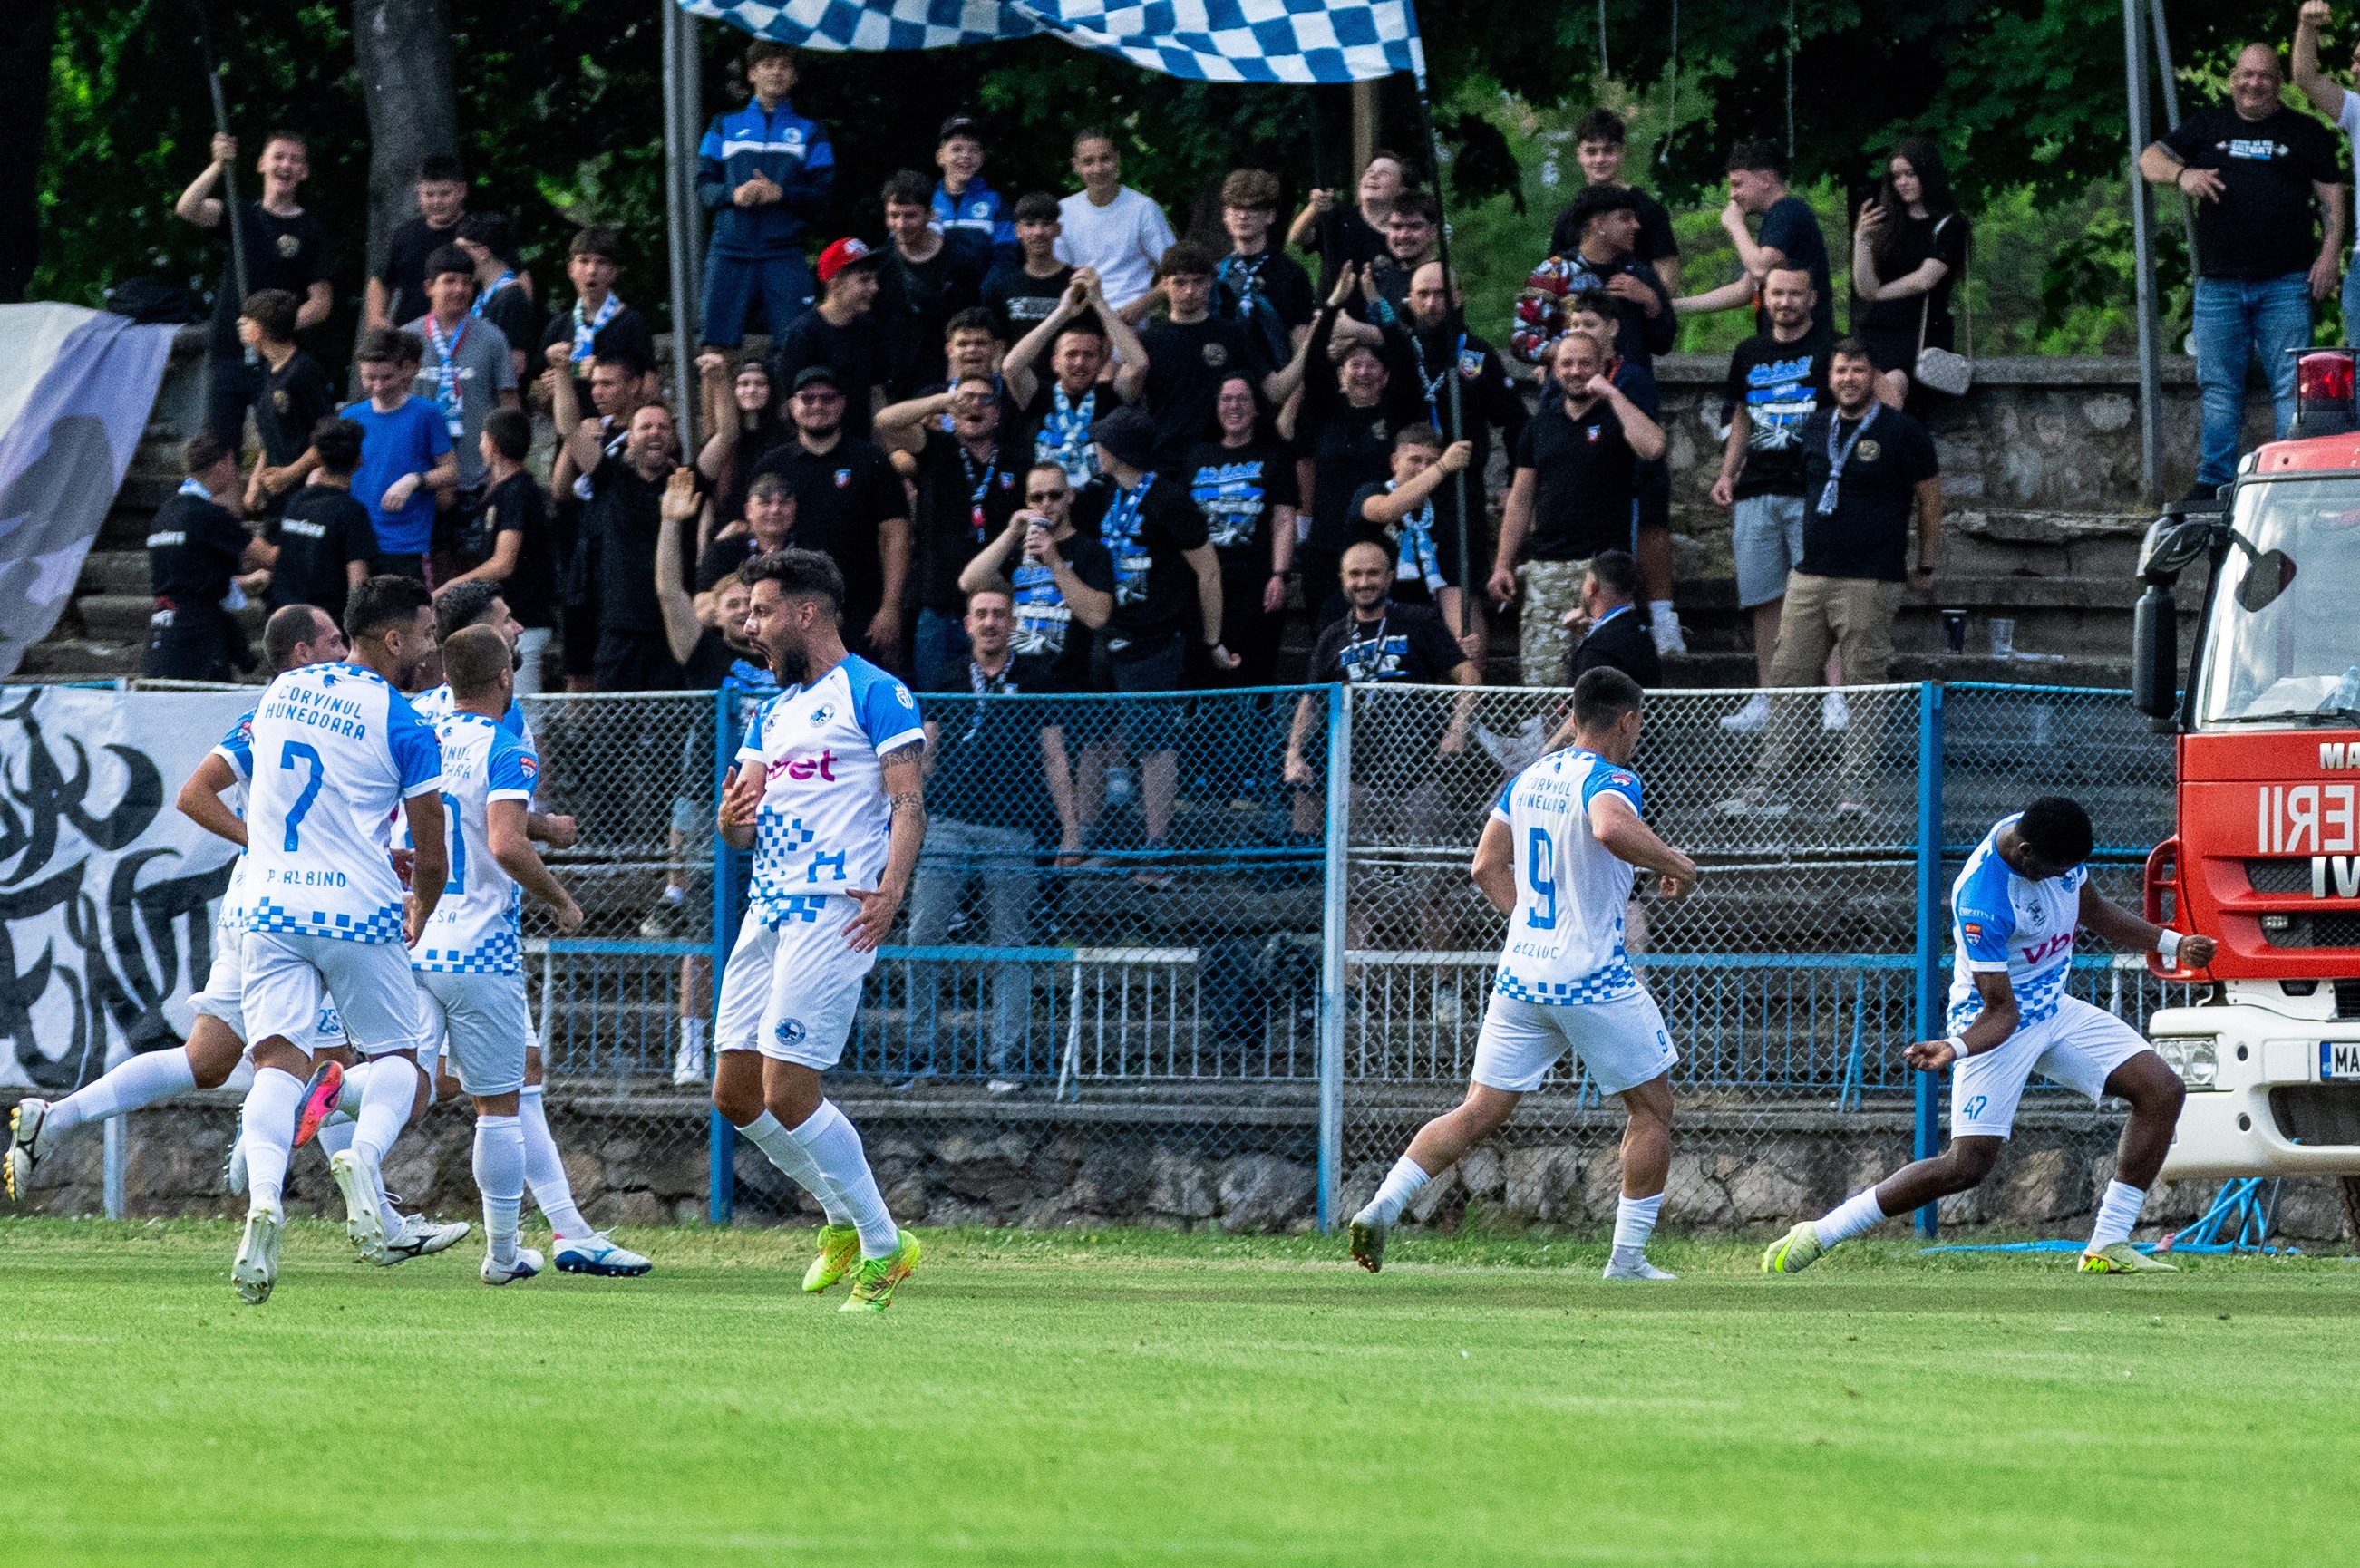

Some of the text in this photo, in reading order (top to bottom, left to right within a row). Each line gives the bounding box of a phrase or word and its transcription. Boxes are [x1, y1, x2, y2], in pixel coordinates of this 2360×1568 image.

[278, 685, 362, 720] CORVINUL
[265, 702, 366, 740] HUNEDOARA
[280, 740, 324, 852] 7
[1527, 826, 1557, 930] 9
[2312, 856, 2360, 899] IV
[1656, 1029, 1668, 1054] 9
[2335, 1047, 2360, 1073] MA
[1963, 1095, 1987, 1120] 47
